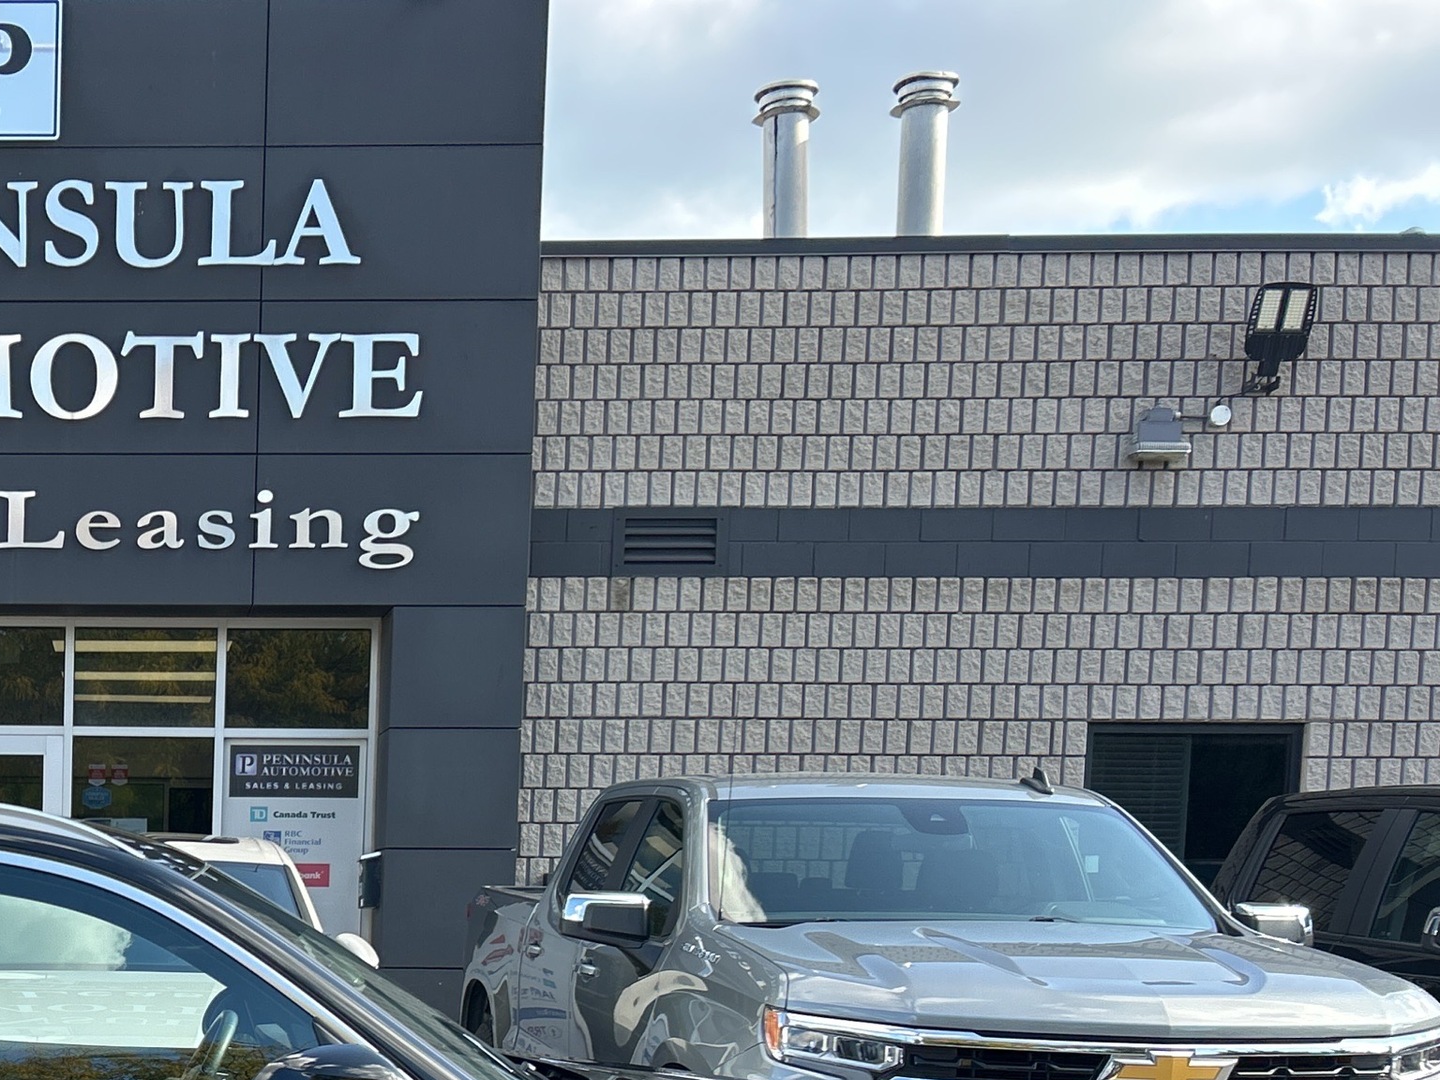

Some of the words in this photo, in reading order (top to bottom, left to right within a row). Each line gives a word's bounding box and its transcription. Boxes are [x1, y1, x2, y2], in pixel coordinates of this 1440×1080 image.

[262, 753, 353, 766] PENINSULA
[239, 755, 255, 774] P
[260, 766, 354, 777] AUTOMOTIVE
[245, 781, 280, 790] SALES
[295, 782, 343, 791] LEASING
[273, 810, 308, 819] Canada
[310, 811, 336, 819] Trust
[284, 830, 303, 838] RBC
[284, 838, 322, 846] Financial
[284, 846, 309, 855] Group
